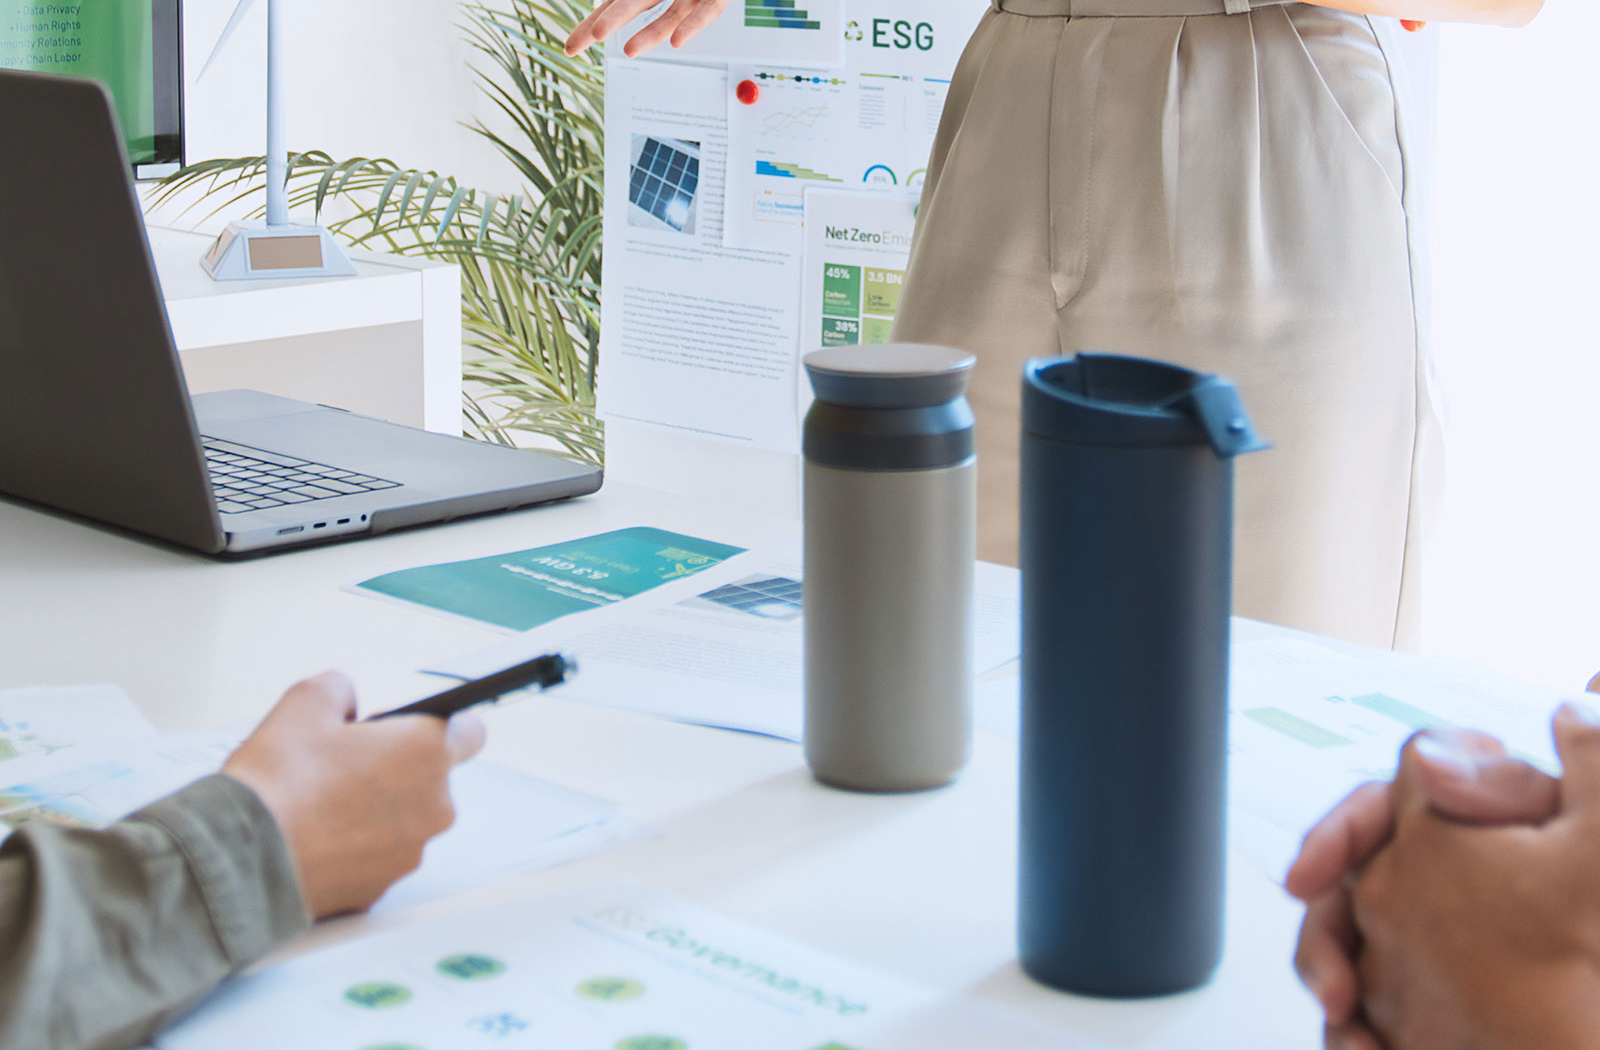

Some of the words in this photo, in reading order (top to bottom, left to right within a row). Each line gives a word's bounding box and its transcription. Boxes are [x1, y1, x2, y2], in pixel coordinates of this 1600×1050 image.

[23, 6, 44, 15] Data
[47, 5, 81, 16] Privacy
[16, 22, 48, 32] Human
[51, 21, 81, 33] Rights
[872, 17, 934, 51] ESG
[38, 37, 81, 47] Relations
[26, 54, 52, 64] Chain
[54, 52, 81, 63] Labor
[825, 225, 848, 240] Net
[850, 229, 881, 244] Zero
[826, 267, 850, 280] 45%
[868, 271, 884, 283] 3.5
[886, 272, 902, 285] BN
[825, 290, 846, 299] Carbon
[835, 320, 857, 333] 38%
[642, 924, 870, 1017] Governance
